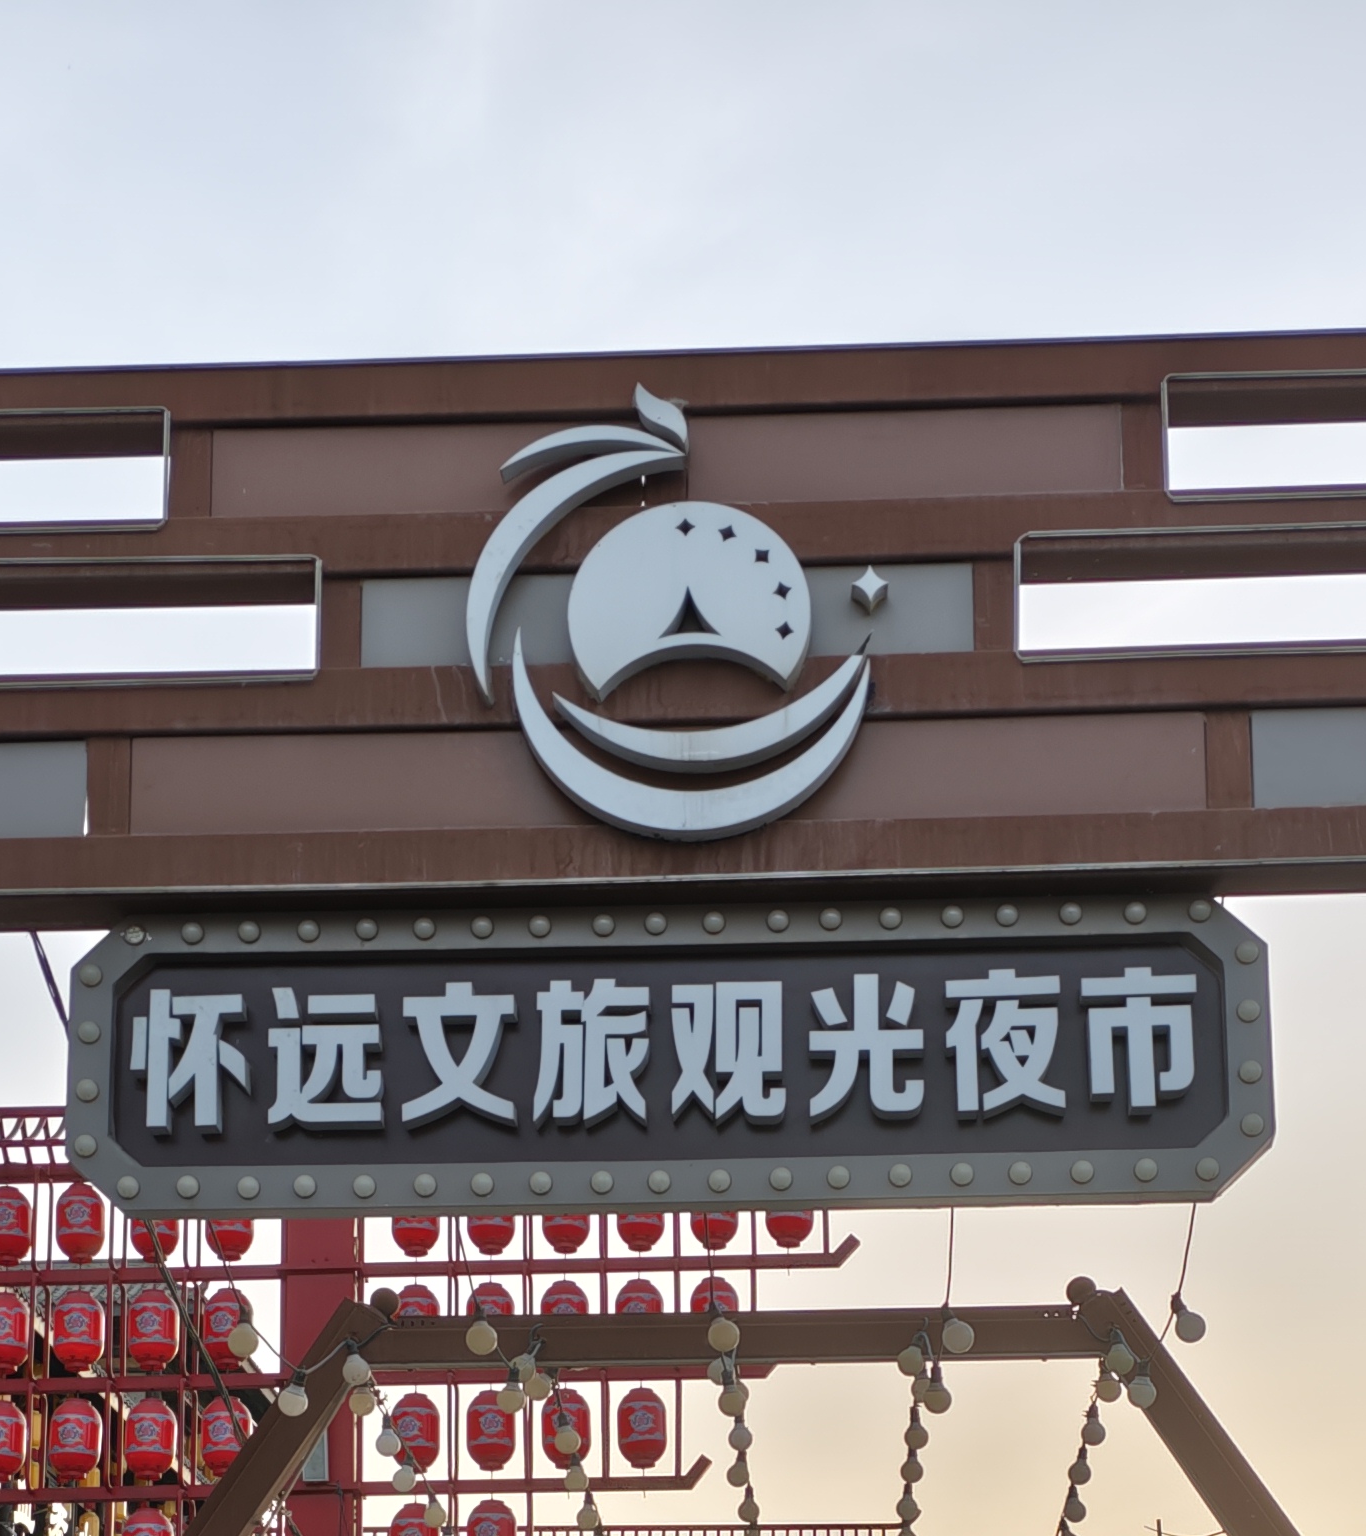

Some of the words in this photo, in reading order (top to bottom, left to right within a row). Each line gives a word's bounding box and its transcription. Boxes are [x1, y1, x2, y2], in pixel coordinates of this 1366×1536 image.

[129, 966, 1197, 1136] 怀远文旅观光夜市
